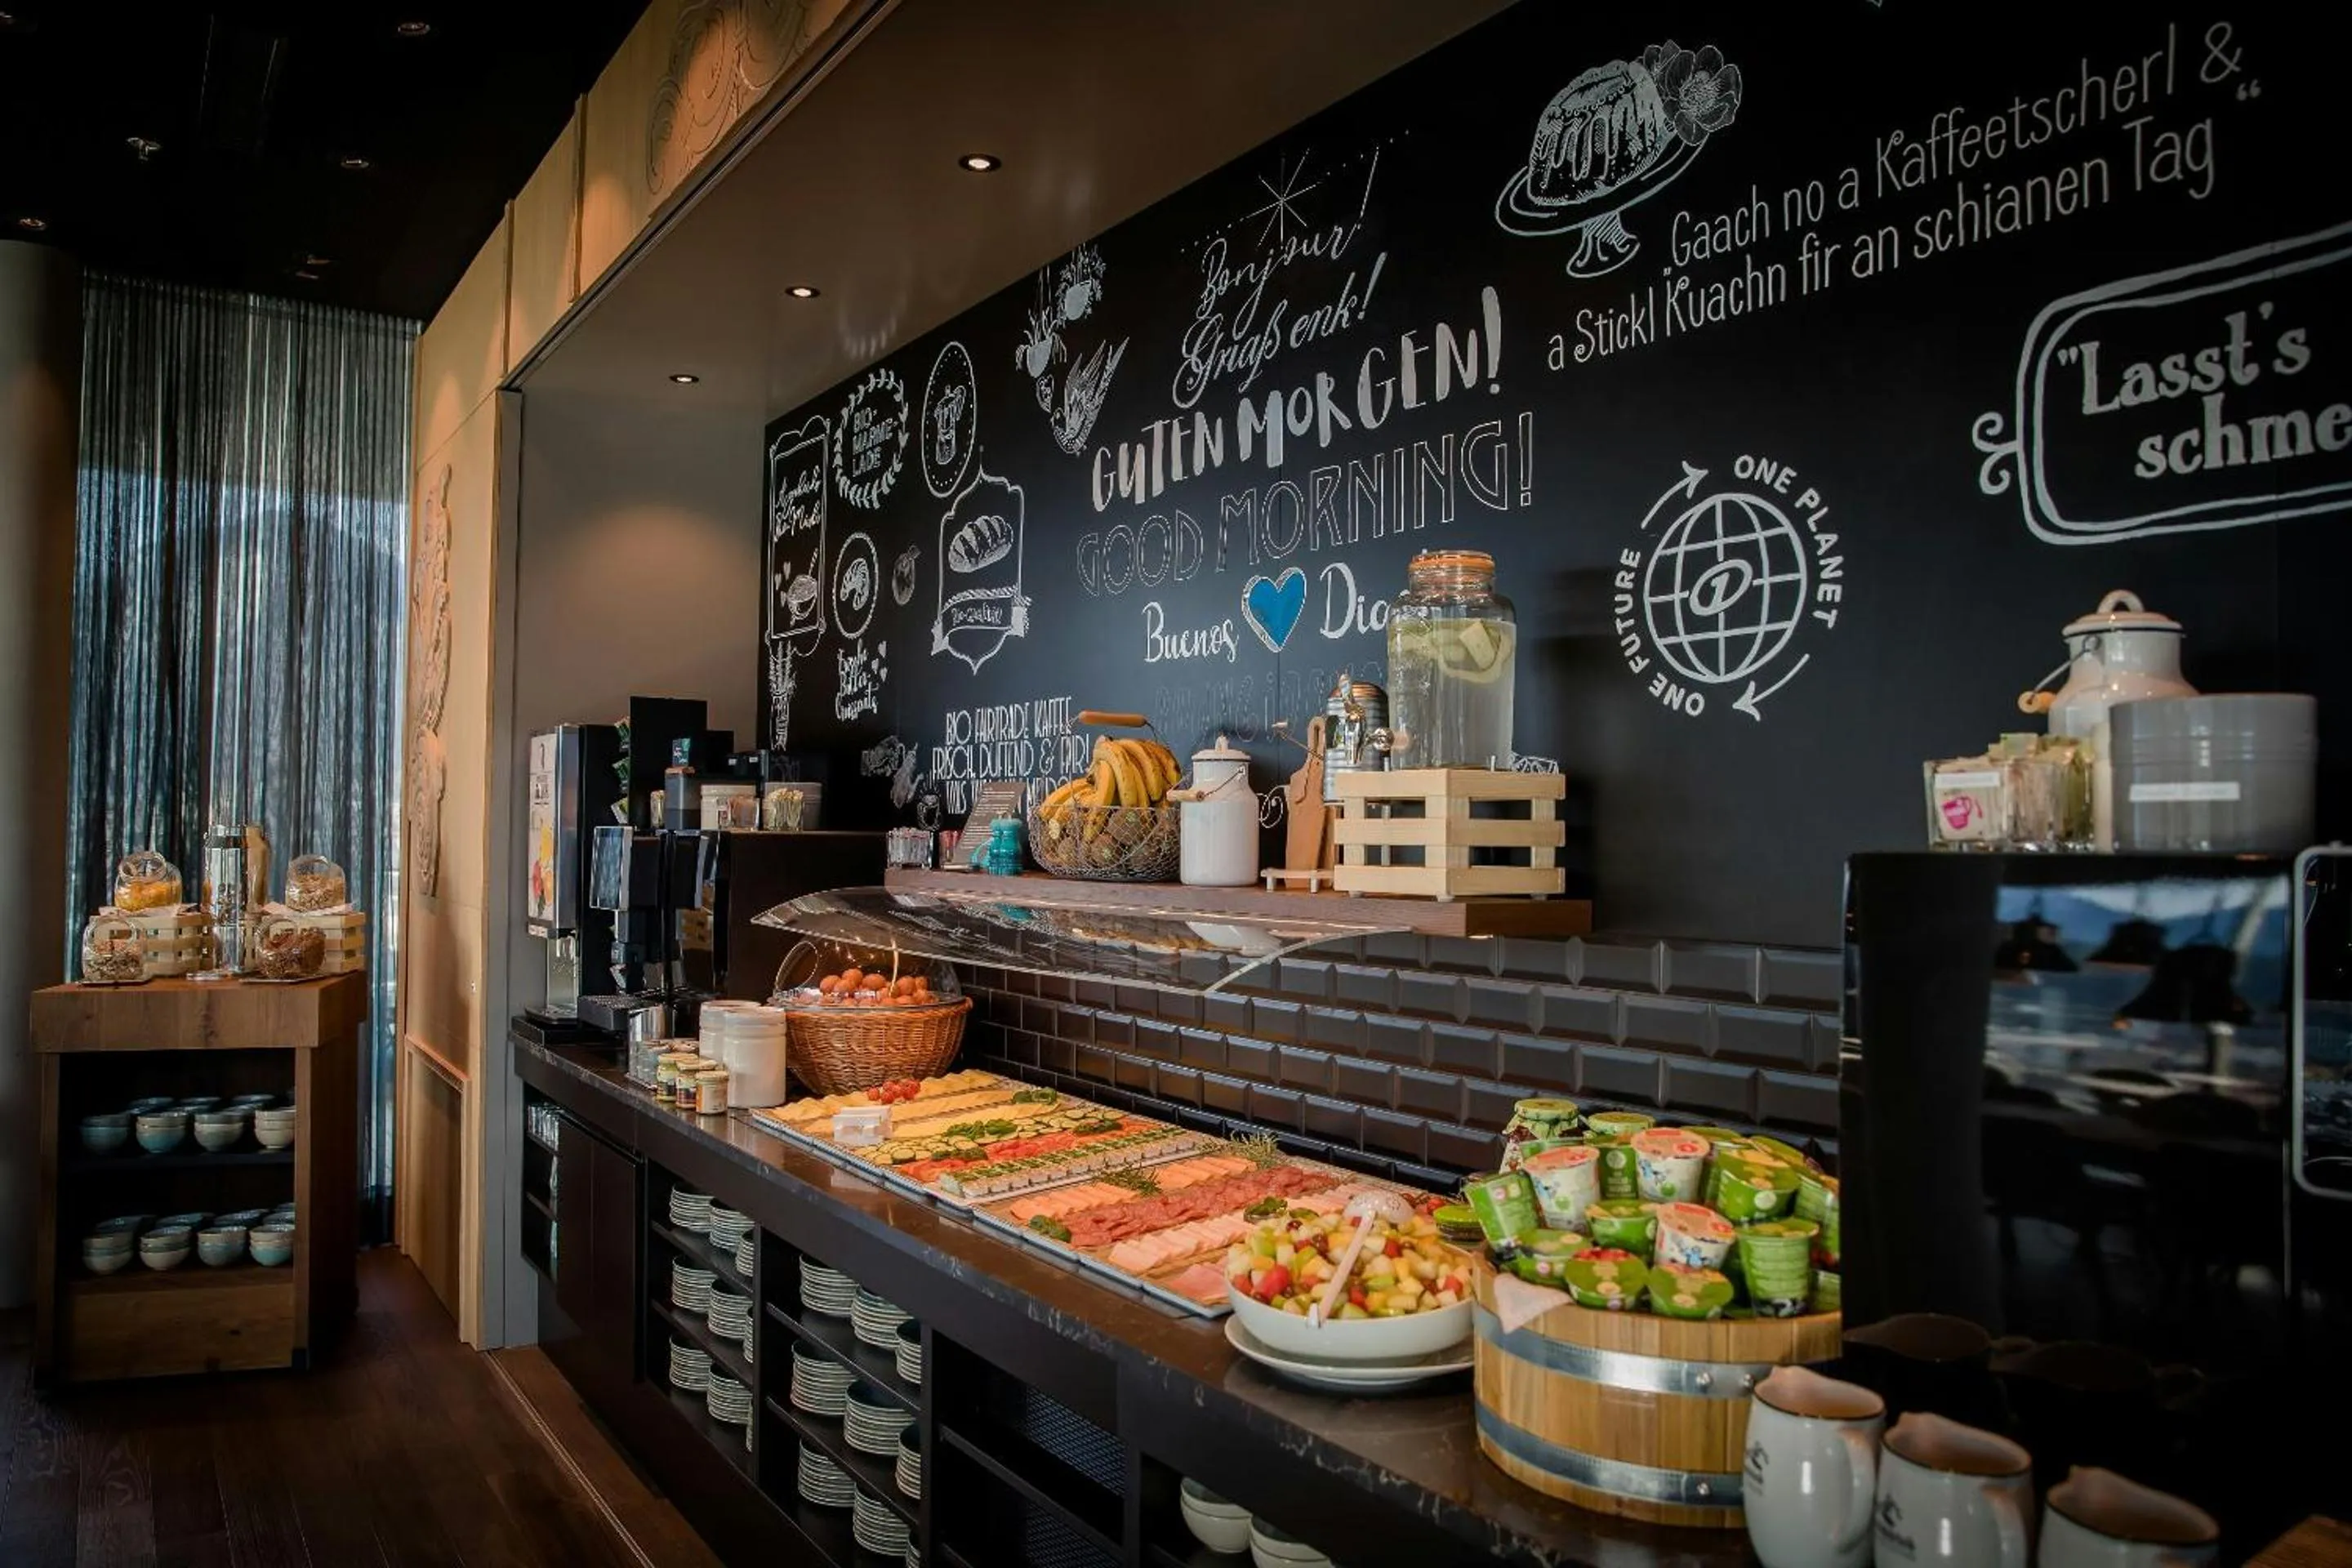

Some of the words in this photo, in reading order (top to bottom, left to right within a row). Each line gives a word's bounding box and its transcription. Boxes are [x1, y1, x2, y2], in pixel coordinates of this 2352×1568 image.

[1784, 180, 1824, 231] no
[1838, 168, 1860, 209] a
[1877, 22, 2176, 198] Kaffeetscherl
[2200, 21, 2243, 83] &
[1290, 252, 1387, 349] enk!
[1548, 335, 1565, 371] a
[1575, 285, 1654, 363] Stickl
[1666, 252, 1787, 336] Kuachn
[1798, 232, 1842, 295] fir
[1851, 225, 1899, 278] an
[1913, 158, 2109, 259] schianen
[1092, 411, 1223, 512] GUTEN
[1237, 285, 1502, 469] MORGEN!
[1076, 509, 1204, 597] GOOD
[1216, 411, 1532, 573] MORNING!
[1734, 454, 1798, 495] ONE
[1794, 488, 1844, 630] PLANET
[1143, 601, 1240, 664] Buenos
[1320, 562, 1410, 639] Dia
[1614, 548, 1651, 675] FUTURE
[946, 710, 971, 745] BIO
[1647, 671, 1706, 717] ONE
[979, 739, 1034, 778] DUFTEND
